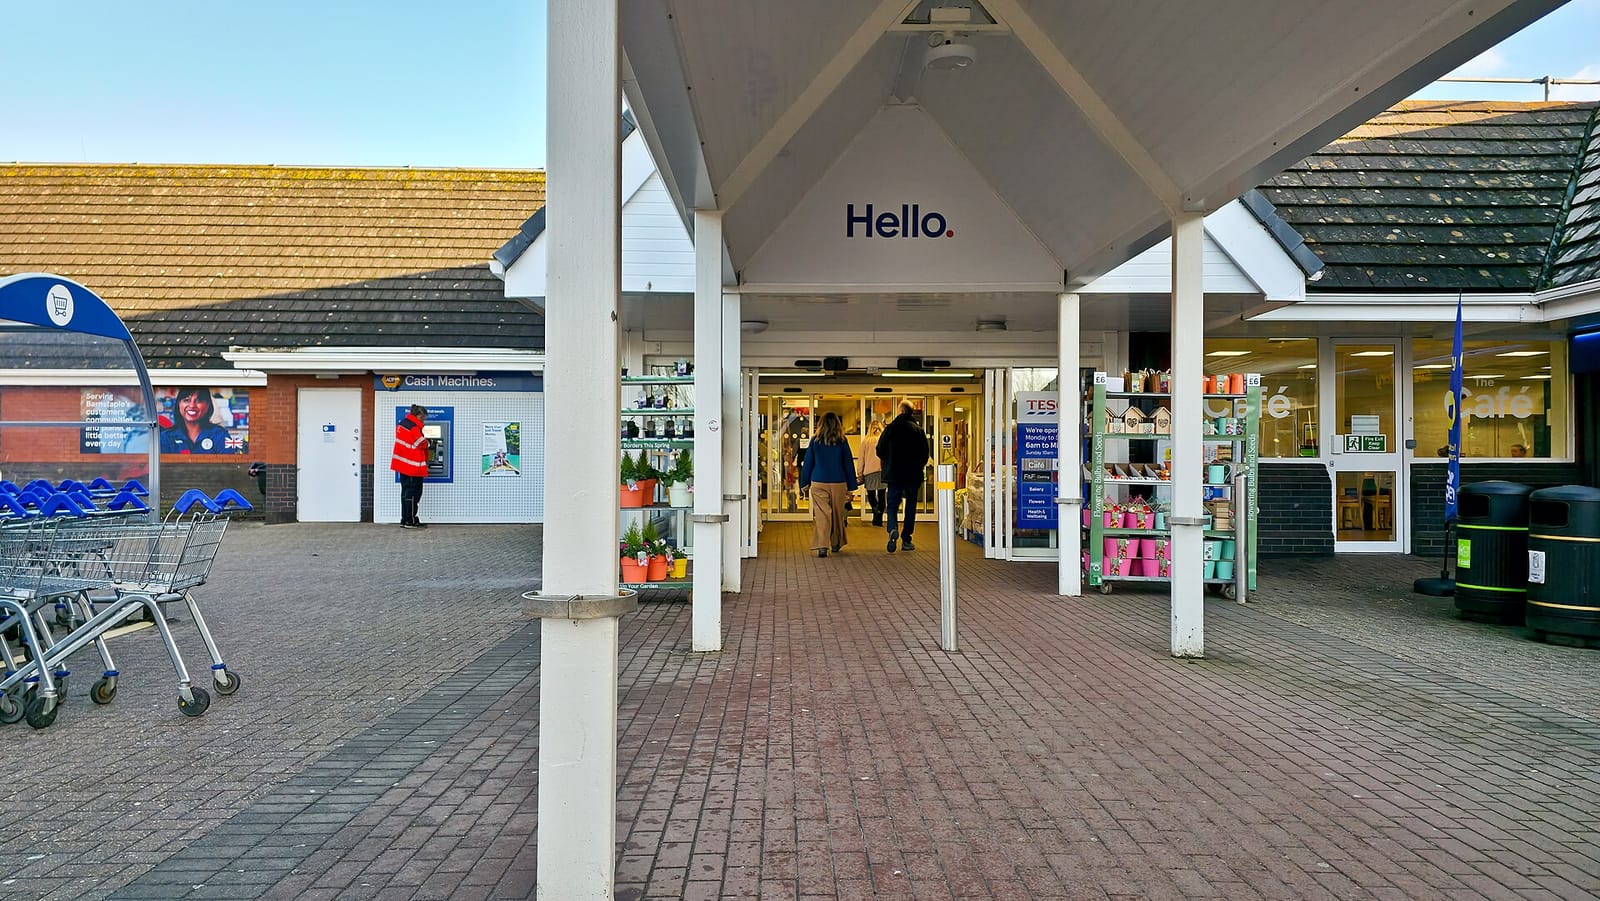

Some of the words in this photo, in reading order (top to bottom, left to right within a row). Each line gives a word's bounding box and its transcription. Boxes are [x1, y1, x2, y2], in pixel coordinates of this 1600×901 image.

[847, 204, 954, 238] Hello.
[405, 376, 434, 386] Cash
[438, 375, 496, 386] Machines.
[1249, 377, 1259, 385] £6
[1475, 378, 1494, 387] The
[86, 393, 113, 401] Serving
[1026, 400, 1058, 410] TES
[1444, 386, 1533, 419] Café
[1095, 432, 1103, 451] Seeds
[1248, 433, 1256, 453] Seeds
[1094, 466, 1102, 483] Bulbs
[1093, 484, 1103, 518] Flowering
[1248, 487, 1256, 521] Flowering
